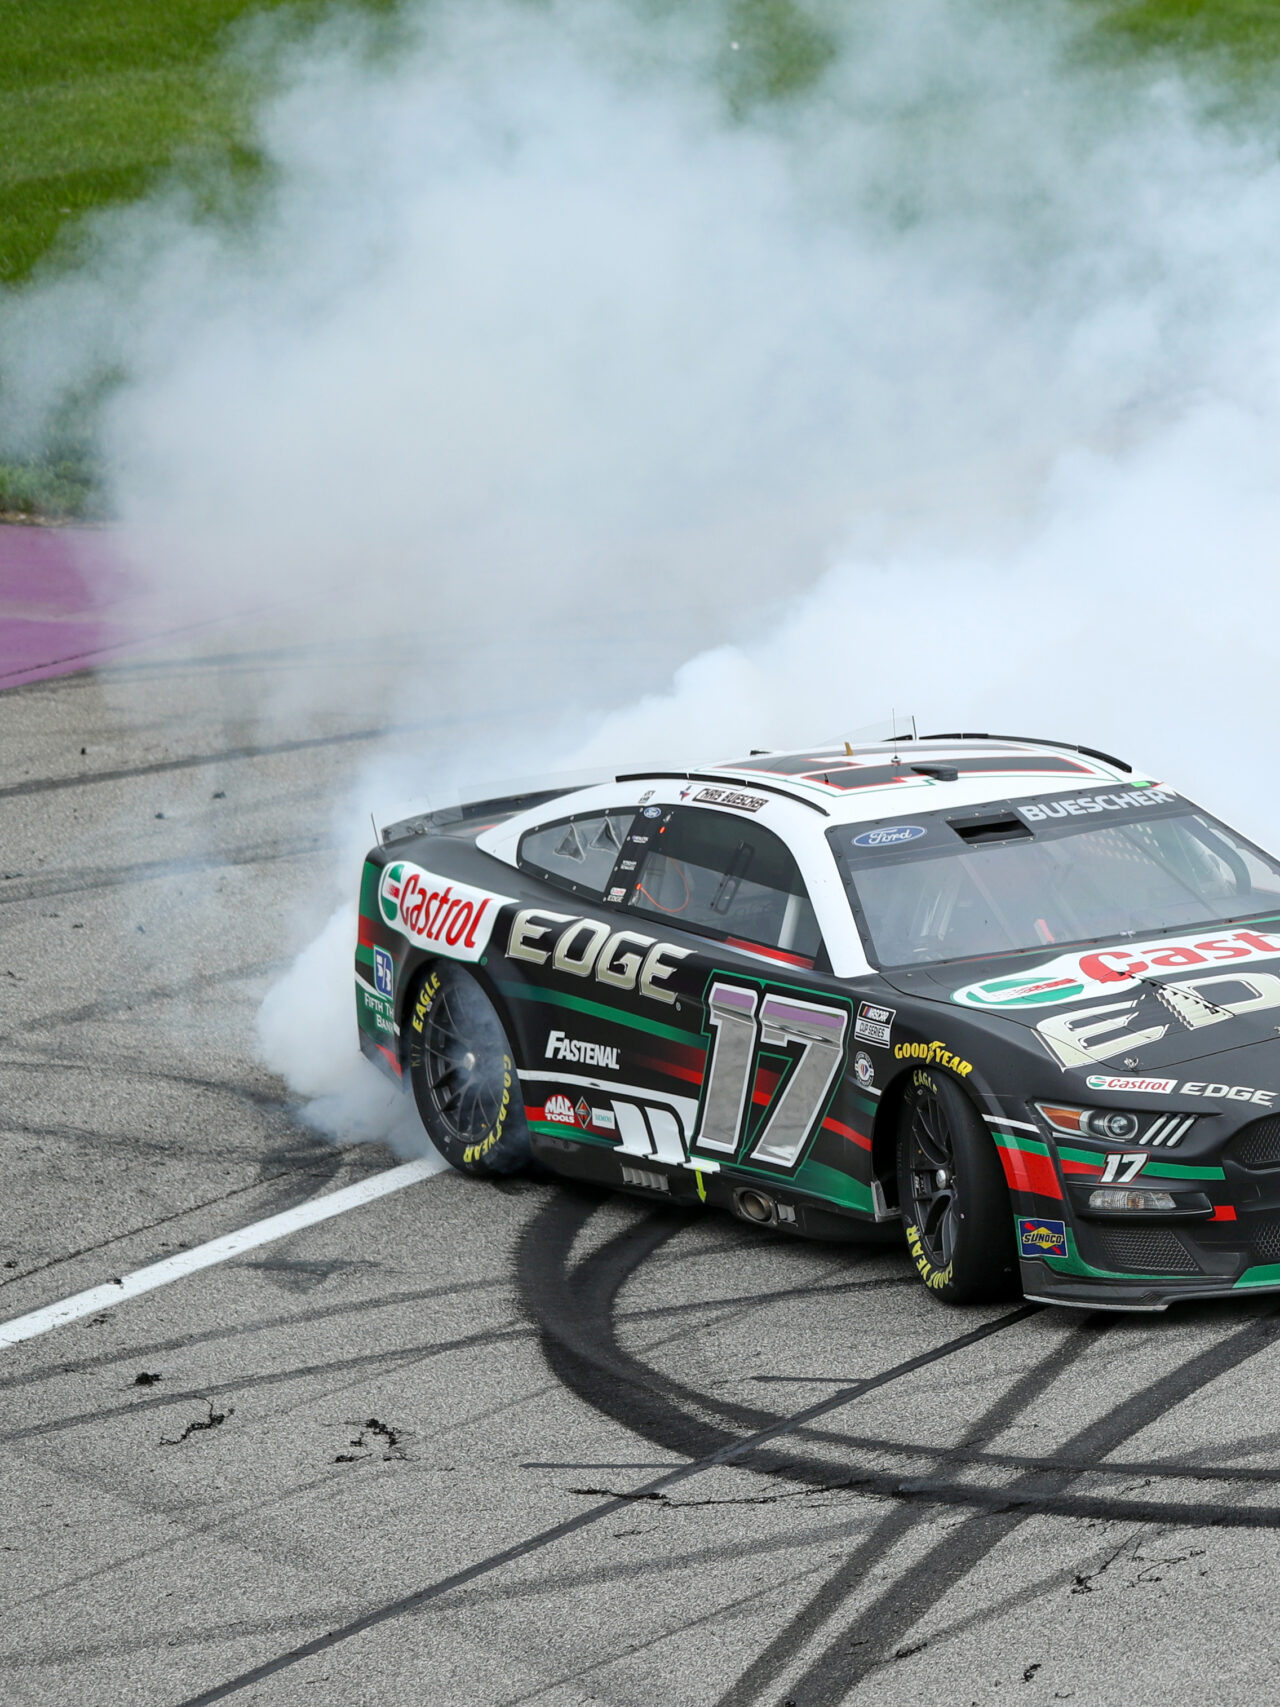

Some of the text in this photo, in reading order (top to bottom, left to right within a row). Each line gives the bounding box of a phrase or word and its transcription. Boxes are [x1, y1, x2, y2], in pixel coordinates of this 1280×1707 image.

[1018, 790, 1174, 822] BUESCHER
[400, 873, 495, 949] Castrol
[505, 908, 698, 1005] EDGE
[364, 992, 384, 1014] FIFTH
[412, 971, 441, 1033] EAGLE
[859, 1022, 886, 1039] CUP SERIES
[544, 1029, 620, 1070] FASTENAL
[894, 1041, 974, 1078] GOODYEAR
[696, 981, 848, 1168] 17
[462, 1053, 512, 1163] GOODYEAR
[544, 1095, 575, 1116] MAC
[1107, 1078, 1280, 1106] Castrol EDGE
[545, 1113, 575, 1124] TOOLS
[1100, 1152, 1149, 1184] 17
[1022, 1232, 1064, 1245] SUNOCO
